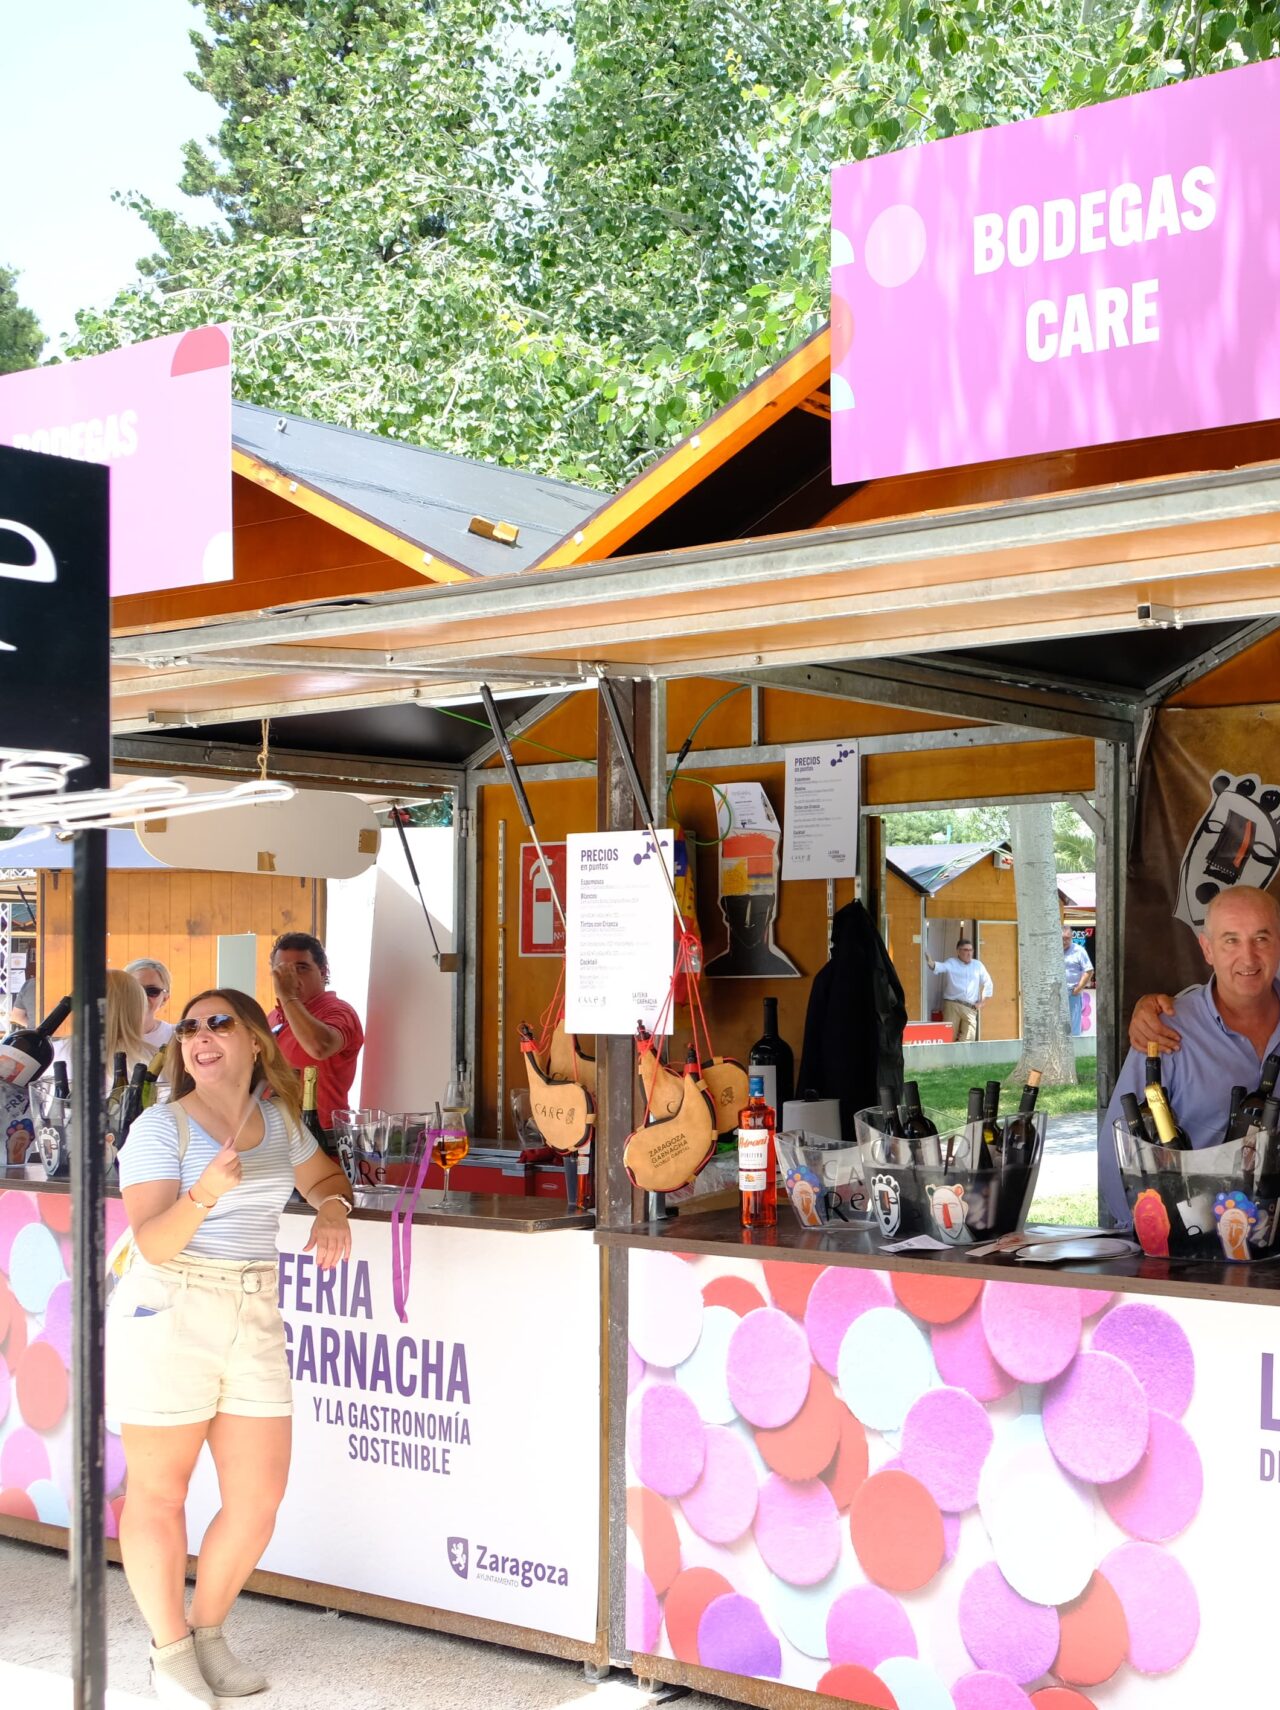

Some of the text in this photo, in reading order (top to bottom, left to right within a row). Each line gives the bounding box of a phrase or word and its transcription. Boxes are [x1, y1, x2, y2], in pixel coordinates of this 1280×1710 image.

[973, 164, 1217, 276] BODEGAS
[1025, 278, 1160, 363] CARE
[795, 756, 820, 767] PRECIOS
[580, 848, 619, 862] PRECIOS
[580, 862, 609, 873] en puntos
[534, 1103, 564, 1121] CARe
[648, 1132, 686, 1158] ZARAGOZA
[651, 1139, 688, 1164] GARNACHA
[278, 1253, 373, 1319] FERIA
[313, 1396, 471, 1446] Y LA GASTRONOMÍA
[348, 1433, 451, 1476] SOSTENIBLE
[476, 1544, 569, 1588] Zaragoza
[476, 1572, 520, 1588] AYUNTAMIENTO
